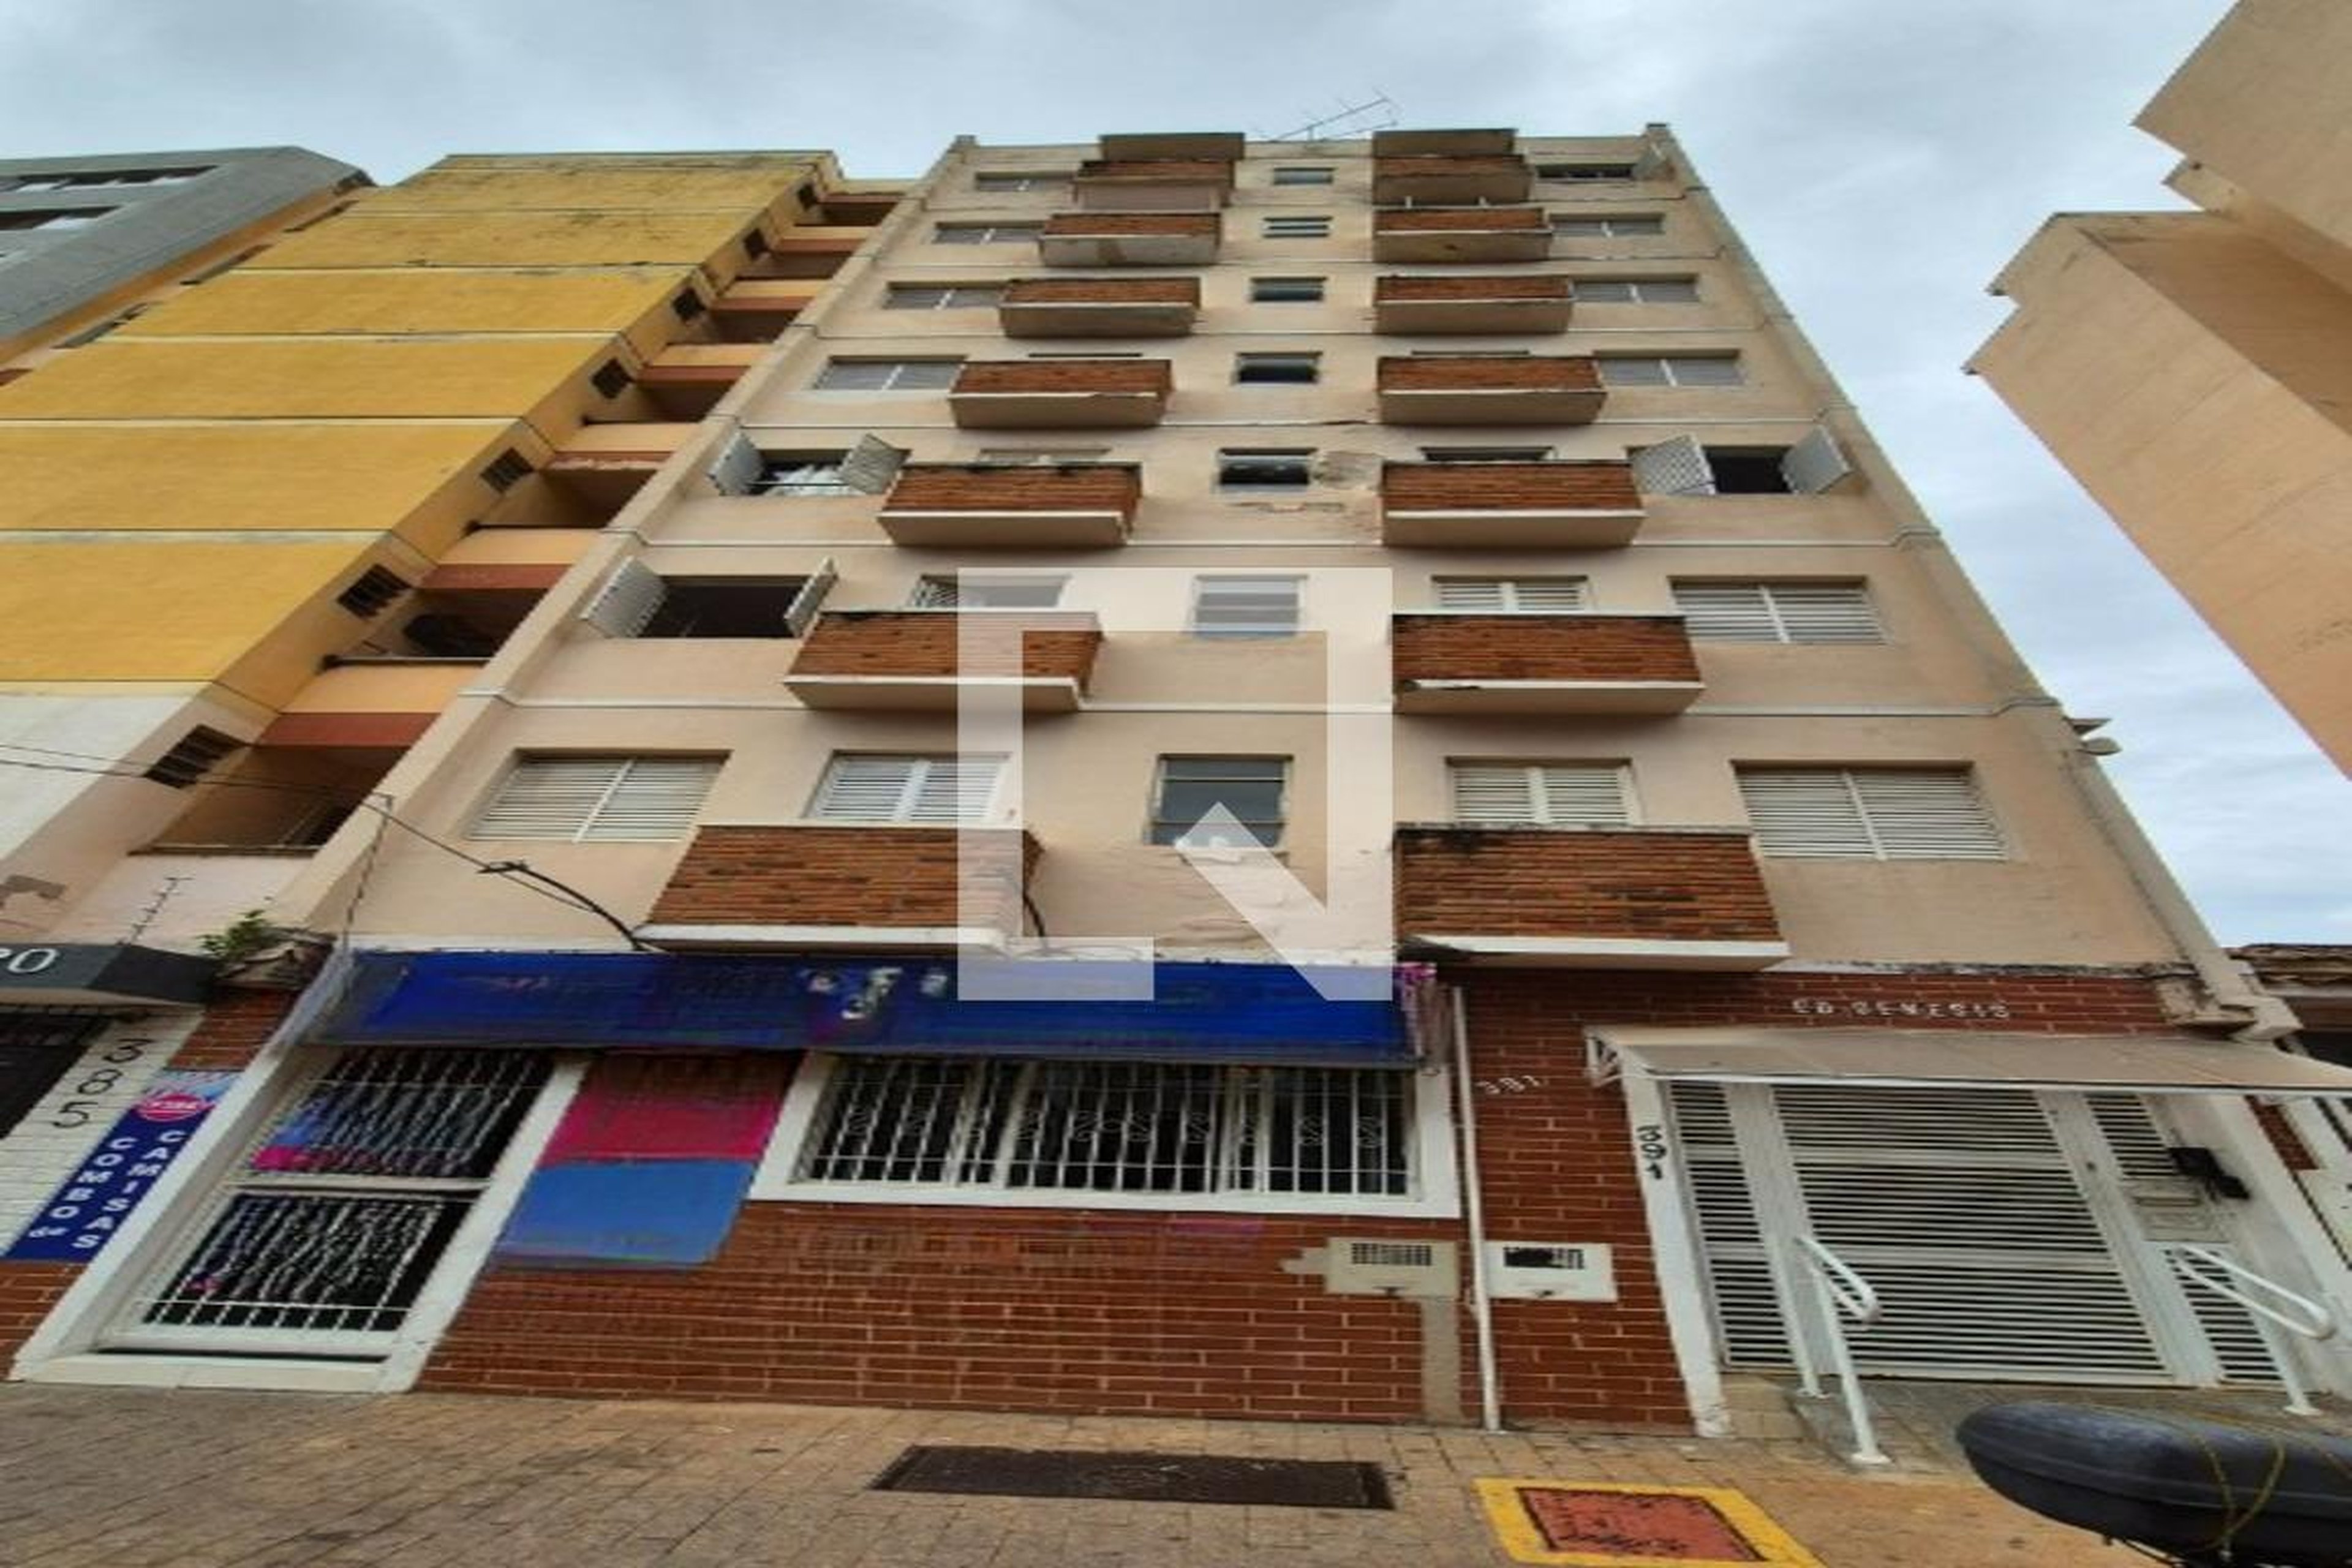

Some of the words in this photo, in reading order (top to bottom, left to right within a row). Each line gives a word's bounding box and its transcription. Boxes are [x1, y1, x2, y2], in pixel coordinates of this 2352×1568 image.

[52, 1038, 156, 1129] 385
[49, 1137, 139, 1219] COMBO
[70, 1130, 186, 1249] CAMISAS
